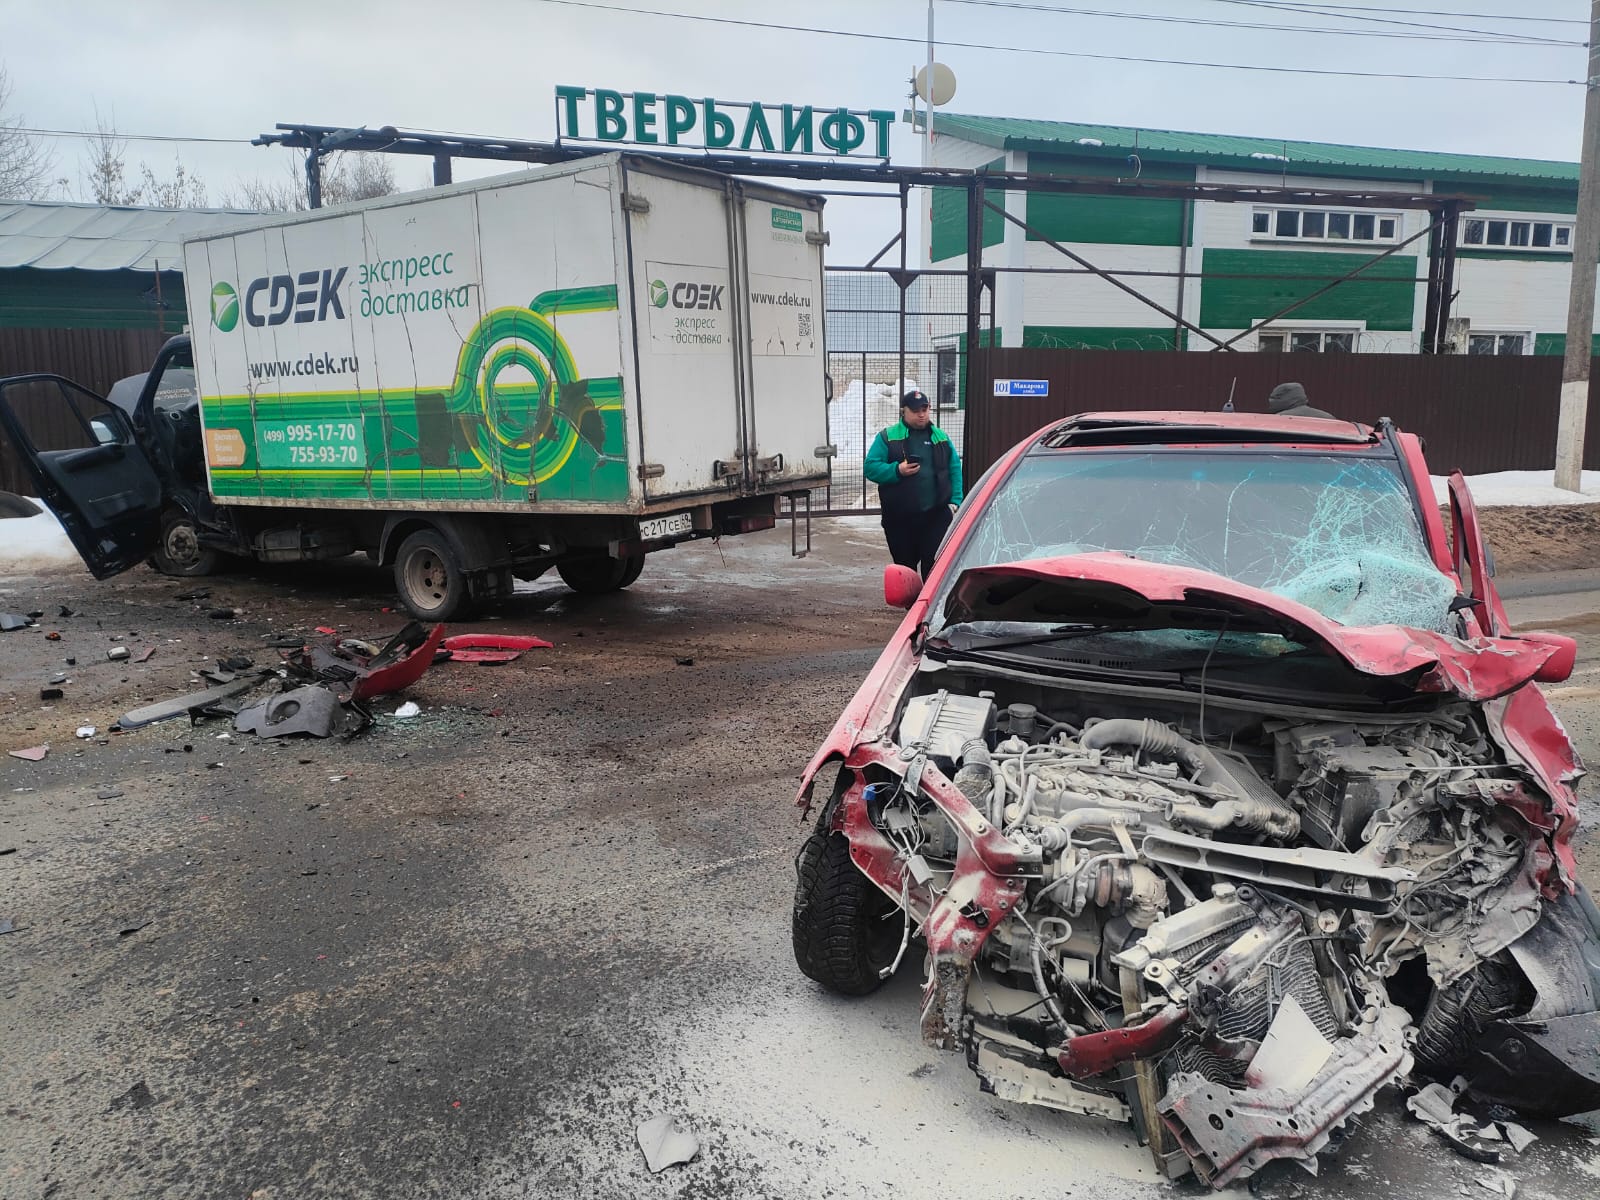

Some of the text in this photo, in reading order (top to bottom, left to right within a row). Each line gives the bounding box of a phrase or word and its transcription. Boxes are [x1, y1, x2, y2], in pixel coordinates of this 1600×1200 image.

[555, 85, 896, 158] ТВЕРЬЛИФТ
[358, 252, 454, 287] экспресс
[245, 266, 349, 328] CDEK
[360, 286, 470, 318] доставка
[672, 282, 725, 310] CDEK
[751, 291, 811, 307] www.cdek.ru
[674, 317, 716, 332] экспресс
[675, 329, 722, 345] доставка
[250, 352, 359, 379] www.cdek.ru
[995, 383, 1008, 392] 101
[263, 423, 356, 443] (499) 995-17-70
[289, 445, 358, 463] 755-93-70
